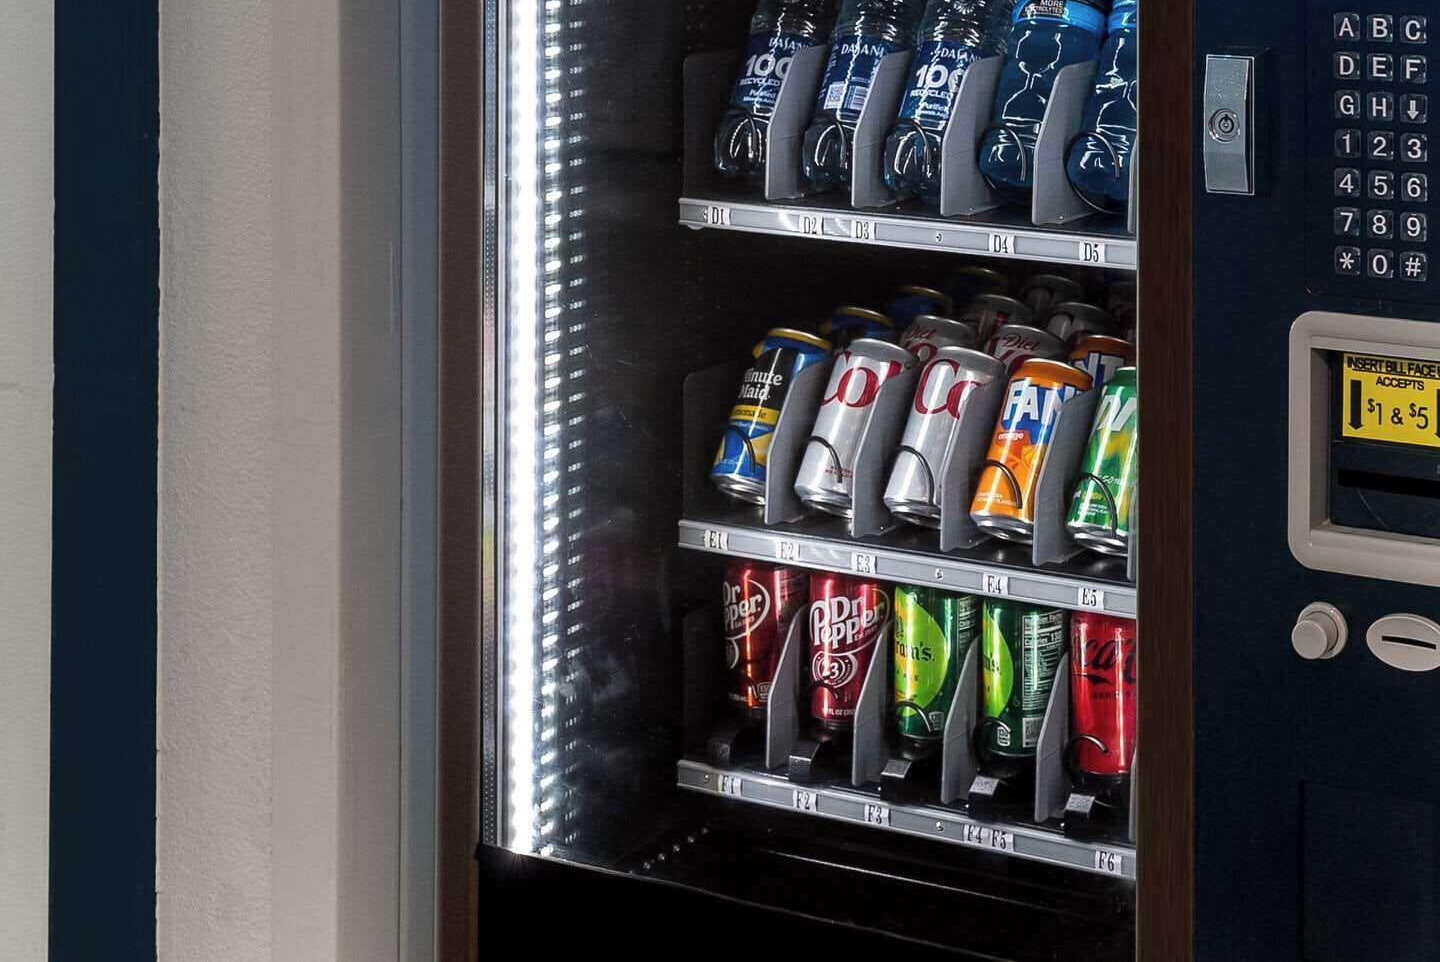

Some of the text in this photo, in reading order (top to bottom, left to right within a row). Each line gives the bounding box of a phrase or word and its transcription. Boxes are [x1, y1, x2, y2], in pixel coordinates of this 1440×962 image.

[1339, 17, 1421, 40] A B C
[1339, 55, 1421, 79] D E F
[1340, 95, 1387, 117] G H
[1342, 133, 1422, 159] 1 2 3
[1339, 173, 1421, 198] 4 5 6
[711, 206, 725, 225] D1
[803, 216, 817, 235] D2
[1340, 212, 1421, 237] 7 8 9
[855, 221, 870, 240] D3
[993, 234, 1008, 254] D4
[1084, 242, 1099, 263] D5
[1372, 254, 1422, 277] 0 #
[1003, 333, 1041, 351] Diet
[1347, 356, 1385, 373] INSERT
[1385, 360, 1406, 375] BILL
[1408, 363, 1437, 378] FACE
[1376, 376, 1425, 391] ACCEPTS
[1367, 398, 1429, 430] $1 & $5
[710, 530, 723, 548] E1
[781, 541, 794, 561] E2
[856, 553, 871, 574] E3
[987, 574, 1002, 594] E4
[1082, 588, 1097, 607] E5
[830, 596, 865, 624] Dr
[796, 791, 811, 811] F2
[869, 804, 882, 824] F3
[967, 825, 1007, 850] F4 F5
[1098, 850, 1116, 872] F6
